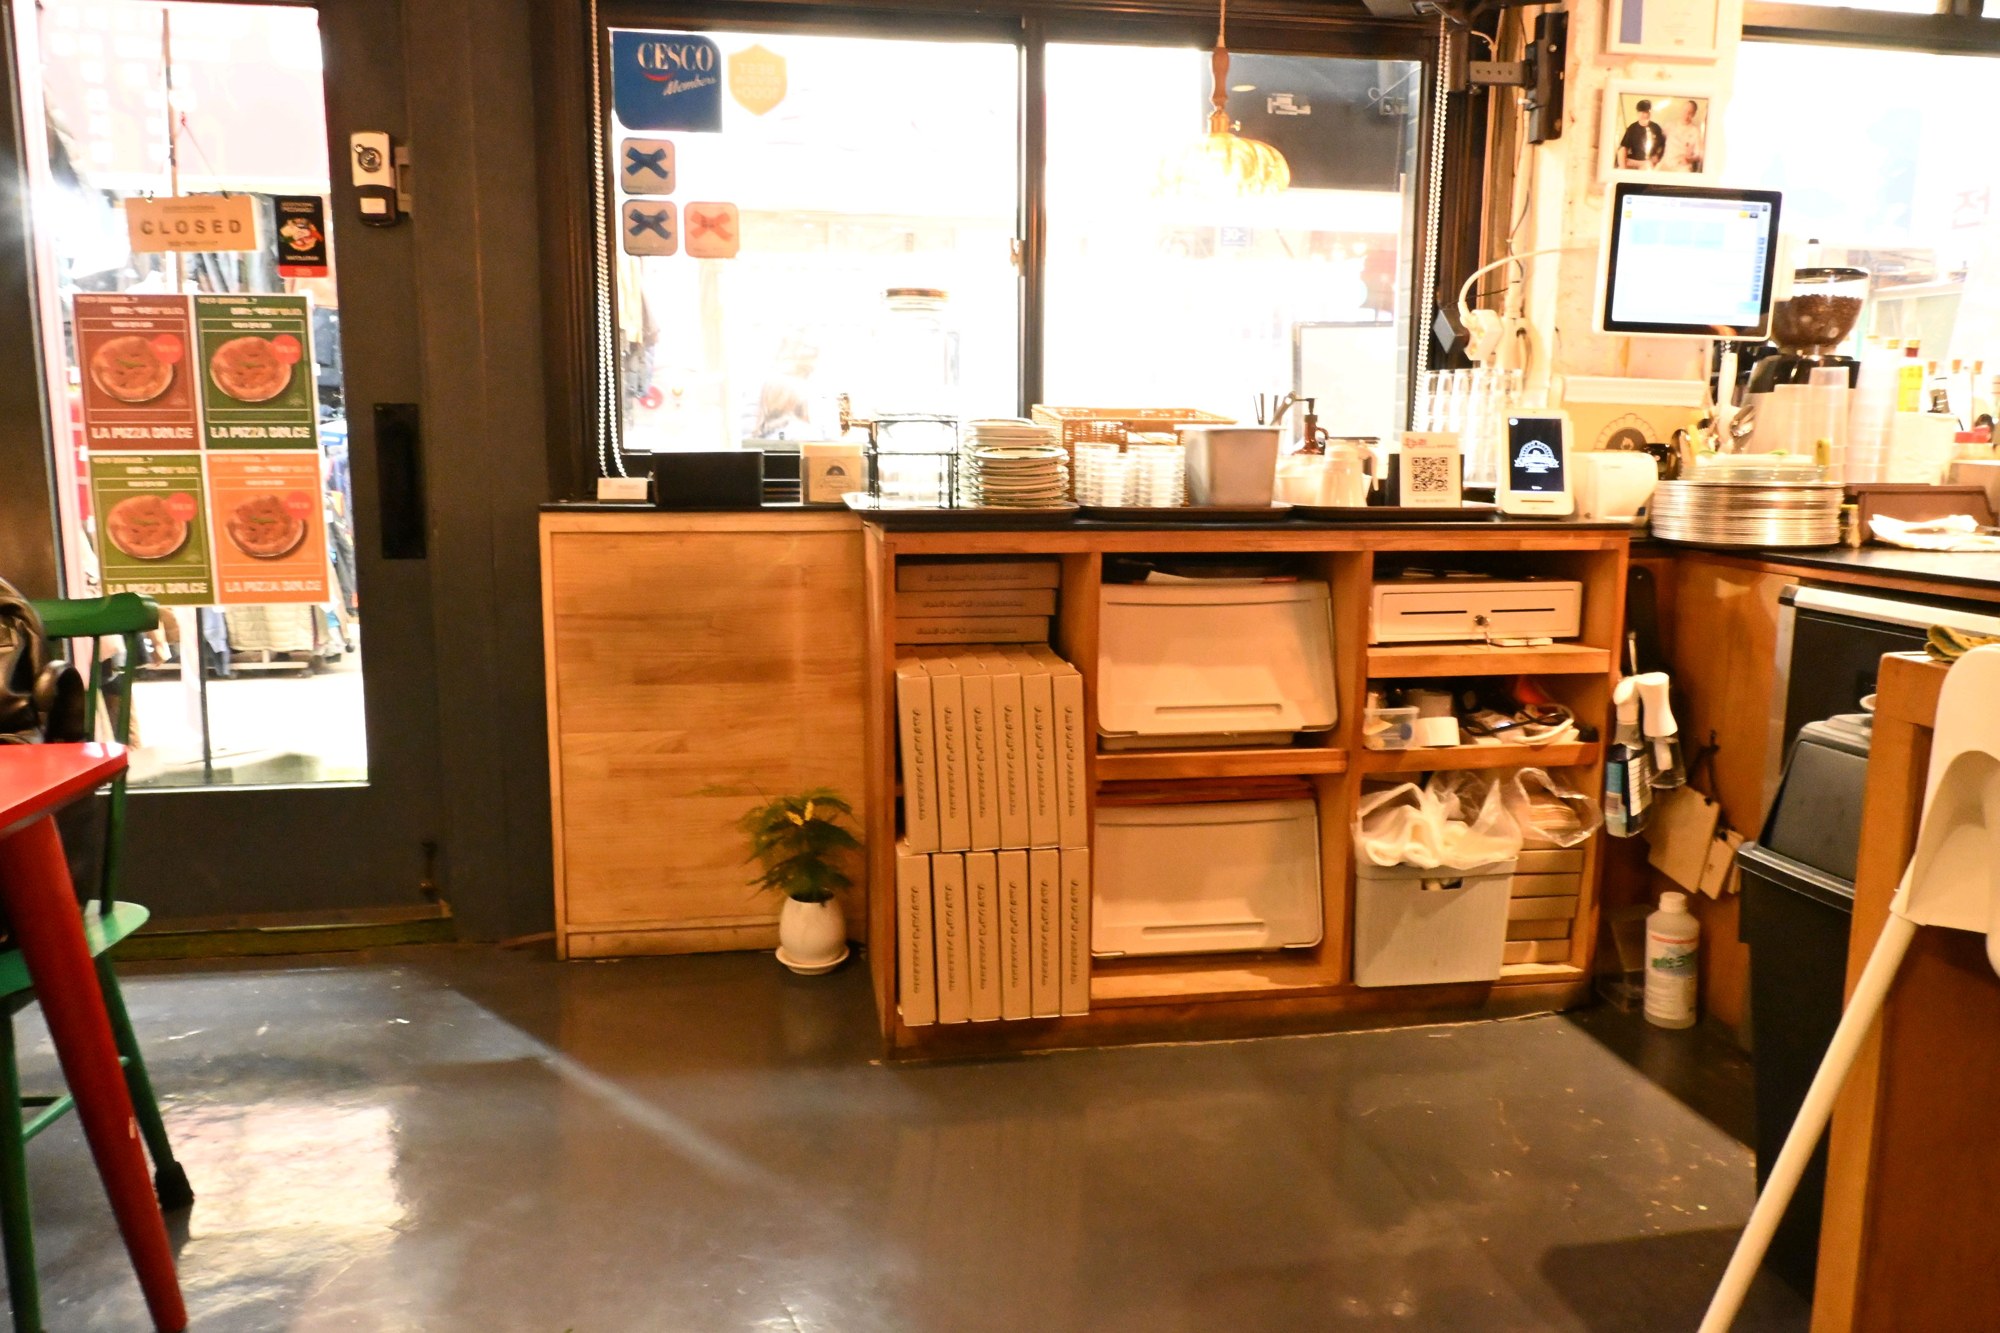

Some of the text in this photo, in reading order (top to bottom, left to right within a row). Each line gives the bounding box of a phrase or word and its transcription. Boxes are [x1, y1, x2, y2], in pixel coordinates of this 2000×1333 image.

[637, 42, 714, 71] CESCO
[140, 219, 243, 235] CLOSED
[91, 427, 194, 439] LA PIZZA DOLCE
[210, 427, 310, 438] LA PIZZA DOLCE
[107, 585, 124, 595] LA
[126, 584, 164, 594] PIZZA
[224, 582, 242, 593] LA
